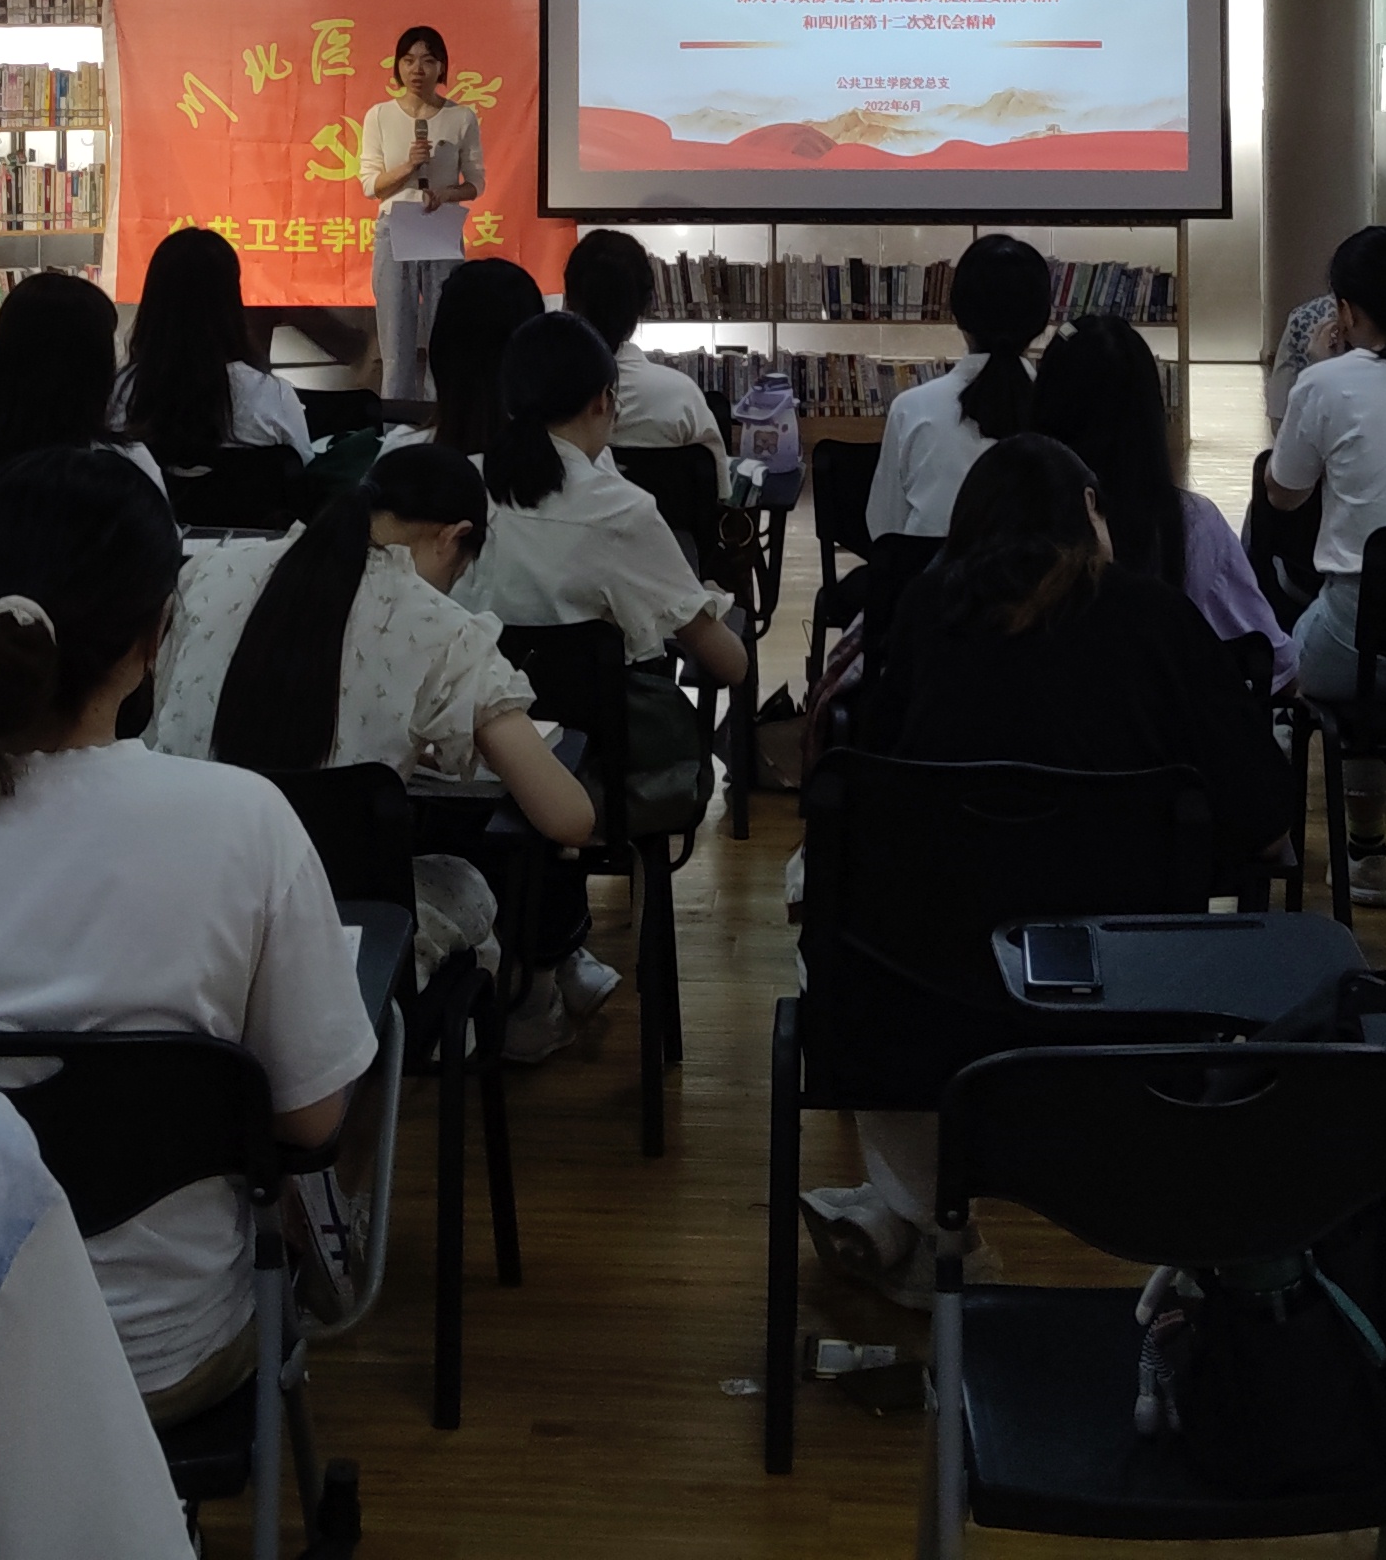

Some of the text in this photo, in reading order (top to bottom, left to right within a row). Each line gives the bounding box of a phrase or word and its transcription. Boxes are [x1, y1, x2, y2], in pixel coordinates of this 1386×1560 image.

[802, 14, 997, 30] 和四川省第十二次党代会精神
[836, 75, 951, 90] 公共卫生学院党总支
[863, 99, 922, 113] 2022年6月
